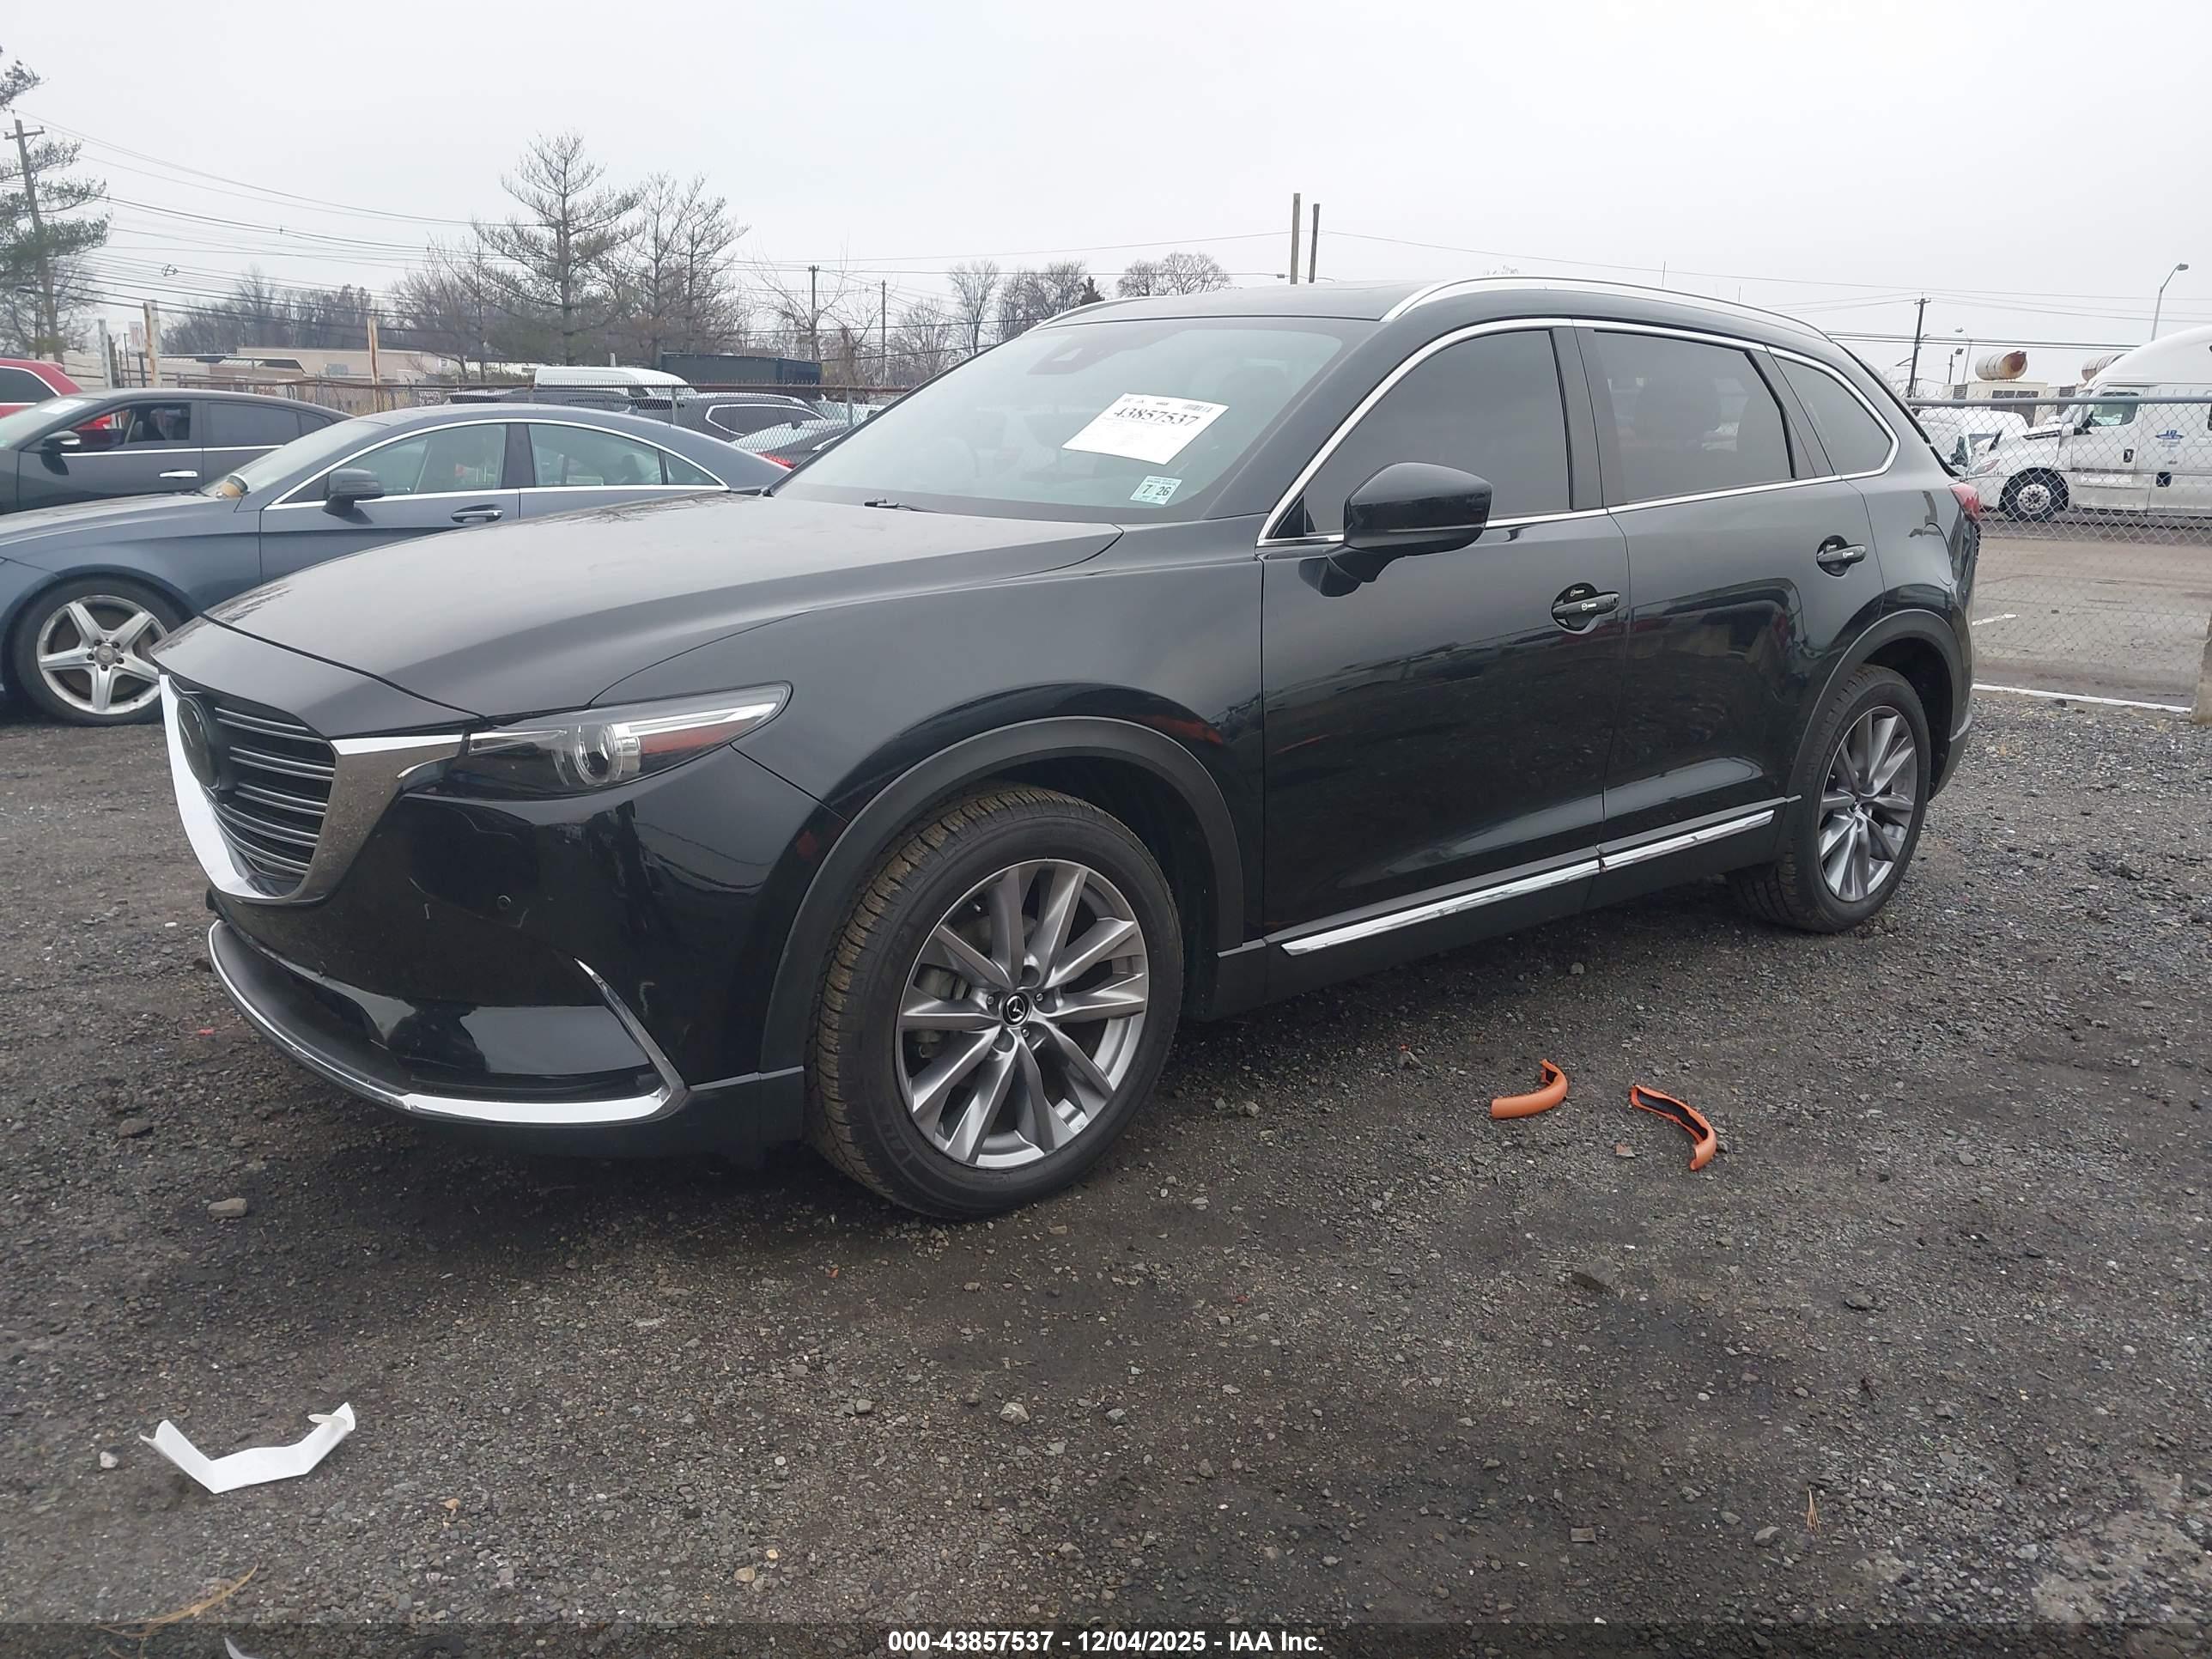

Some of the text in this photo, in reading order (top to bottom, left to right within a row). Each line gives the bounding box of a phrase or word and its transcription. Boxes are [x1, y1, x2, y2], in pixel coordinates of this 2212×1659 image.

[1114, 407, 1200, 426] 43857537
[1142, 484, 1171, 496] 7 26
